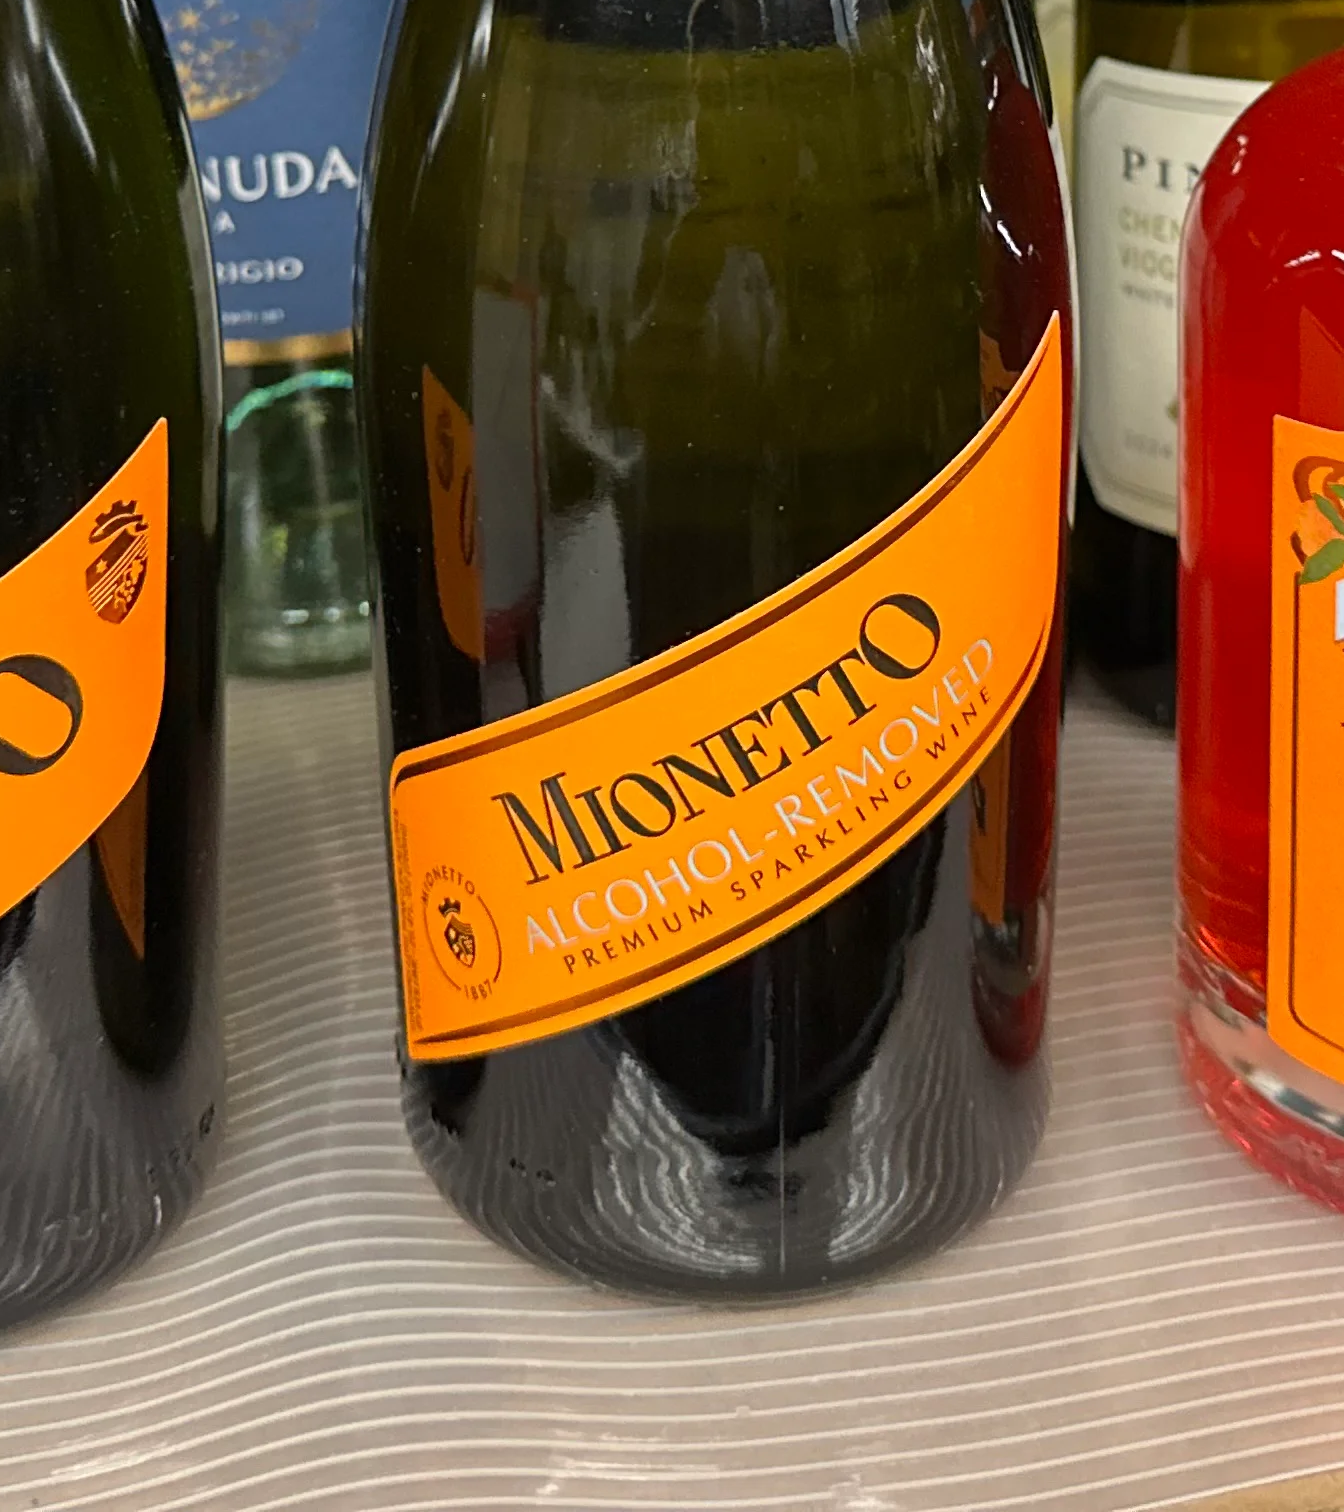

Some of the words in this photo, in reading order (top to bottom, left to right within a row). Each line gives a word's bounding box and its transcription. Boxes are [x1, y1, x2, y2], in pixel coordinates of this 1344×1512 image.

[491, 593, 941, 886] MIONETTO
[525, 638, 994, 955] ALCOHOL-REMOVED
[563, 898, 713, 975] PREMIUM
[730, 769, 914, 902] SPARKLING
[925, 687, 993, 761] WINE
